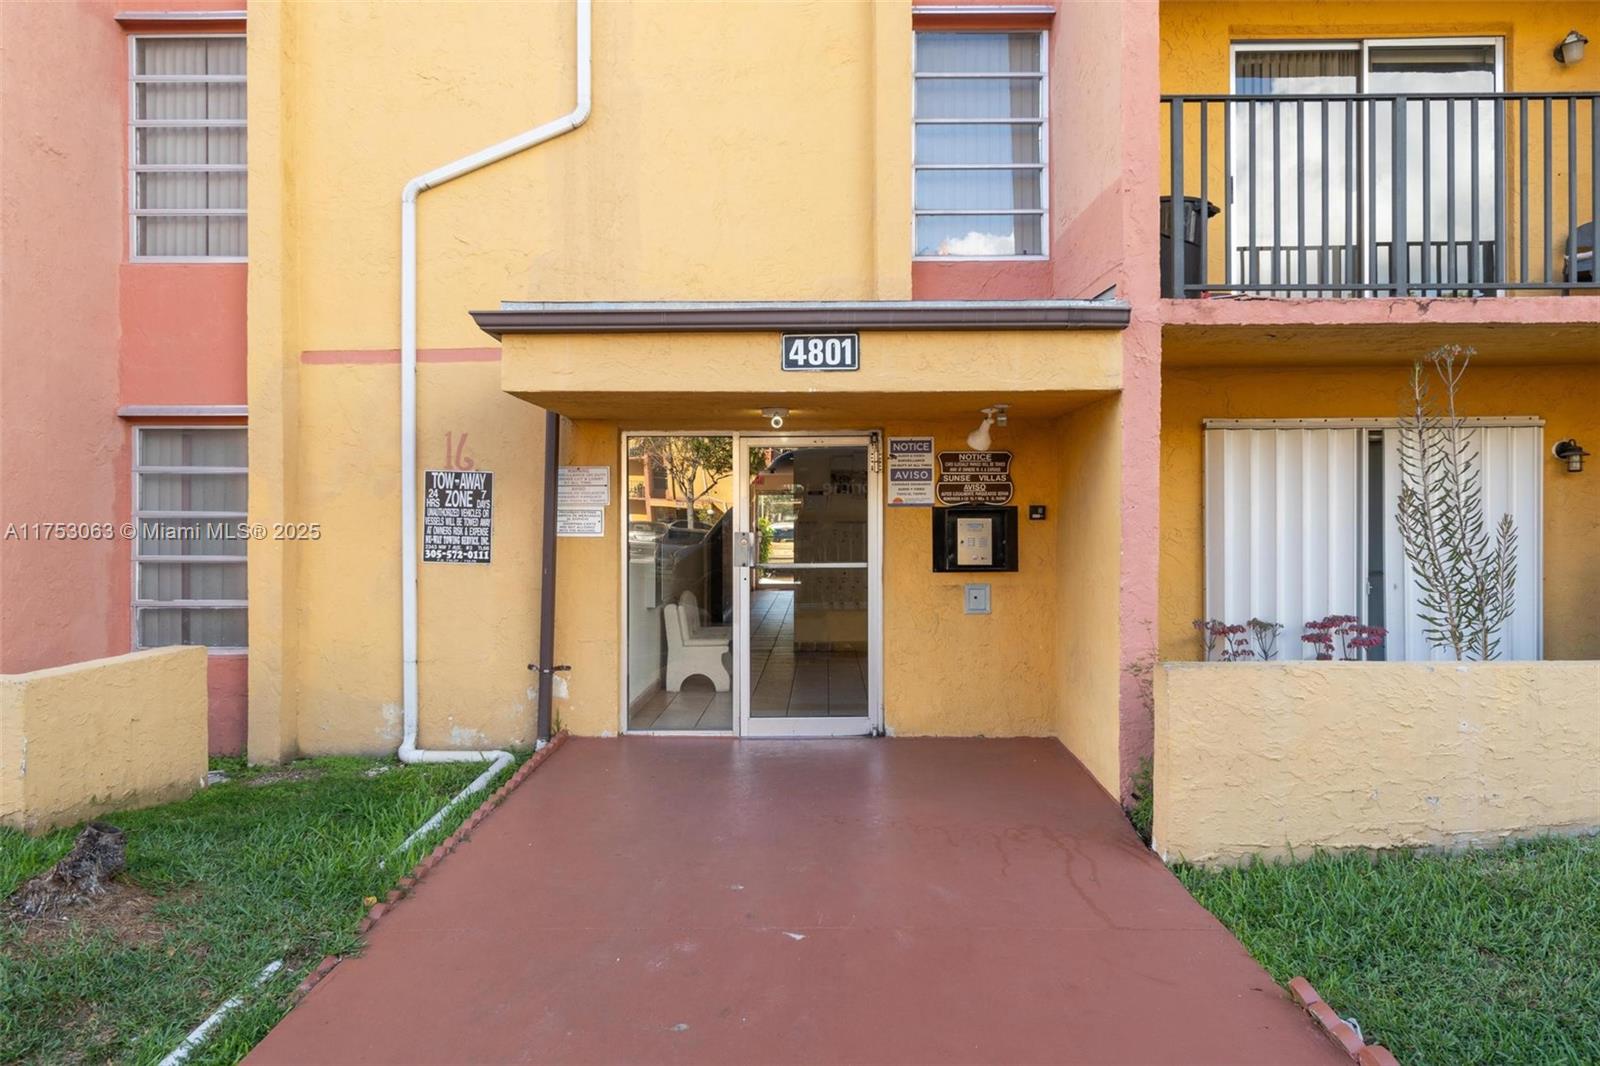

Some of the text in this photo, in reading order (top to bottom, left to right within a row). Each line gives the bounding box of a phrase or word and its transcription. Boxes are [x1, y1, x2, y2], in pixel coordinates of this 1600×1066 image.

[789, 338, 852, 366] 4801
[444, 431, 475, 470] 16
[892, 442, 930, 451] NOTICE
[894, 471, 928, 479] AVISO
[432, 472, 486, 490] TOW-AWAY
[428, 489, 487, 507] 24 ZONE 7
[426, 498, 490, 509] HRS DAYS
[427, 508, 489, 518] UNAUTHORIZED VEHICLES OR
[425, 517, 444, 525] VESSELS
[446, 517, 455, 526] WILL
[456, 518, 463, 526] BE
[464, 518, 479, 526] TOWED
[426, 526, 433, 534] AT
[453, 527, 464, 535] RISK
[464, 527, 468, 536] &
[469, 527, 489, 536] EXPENSE
[425, 550, 489, 559] 305-572-0111
